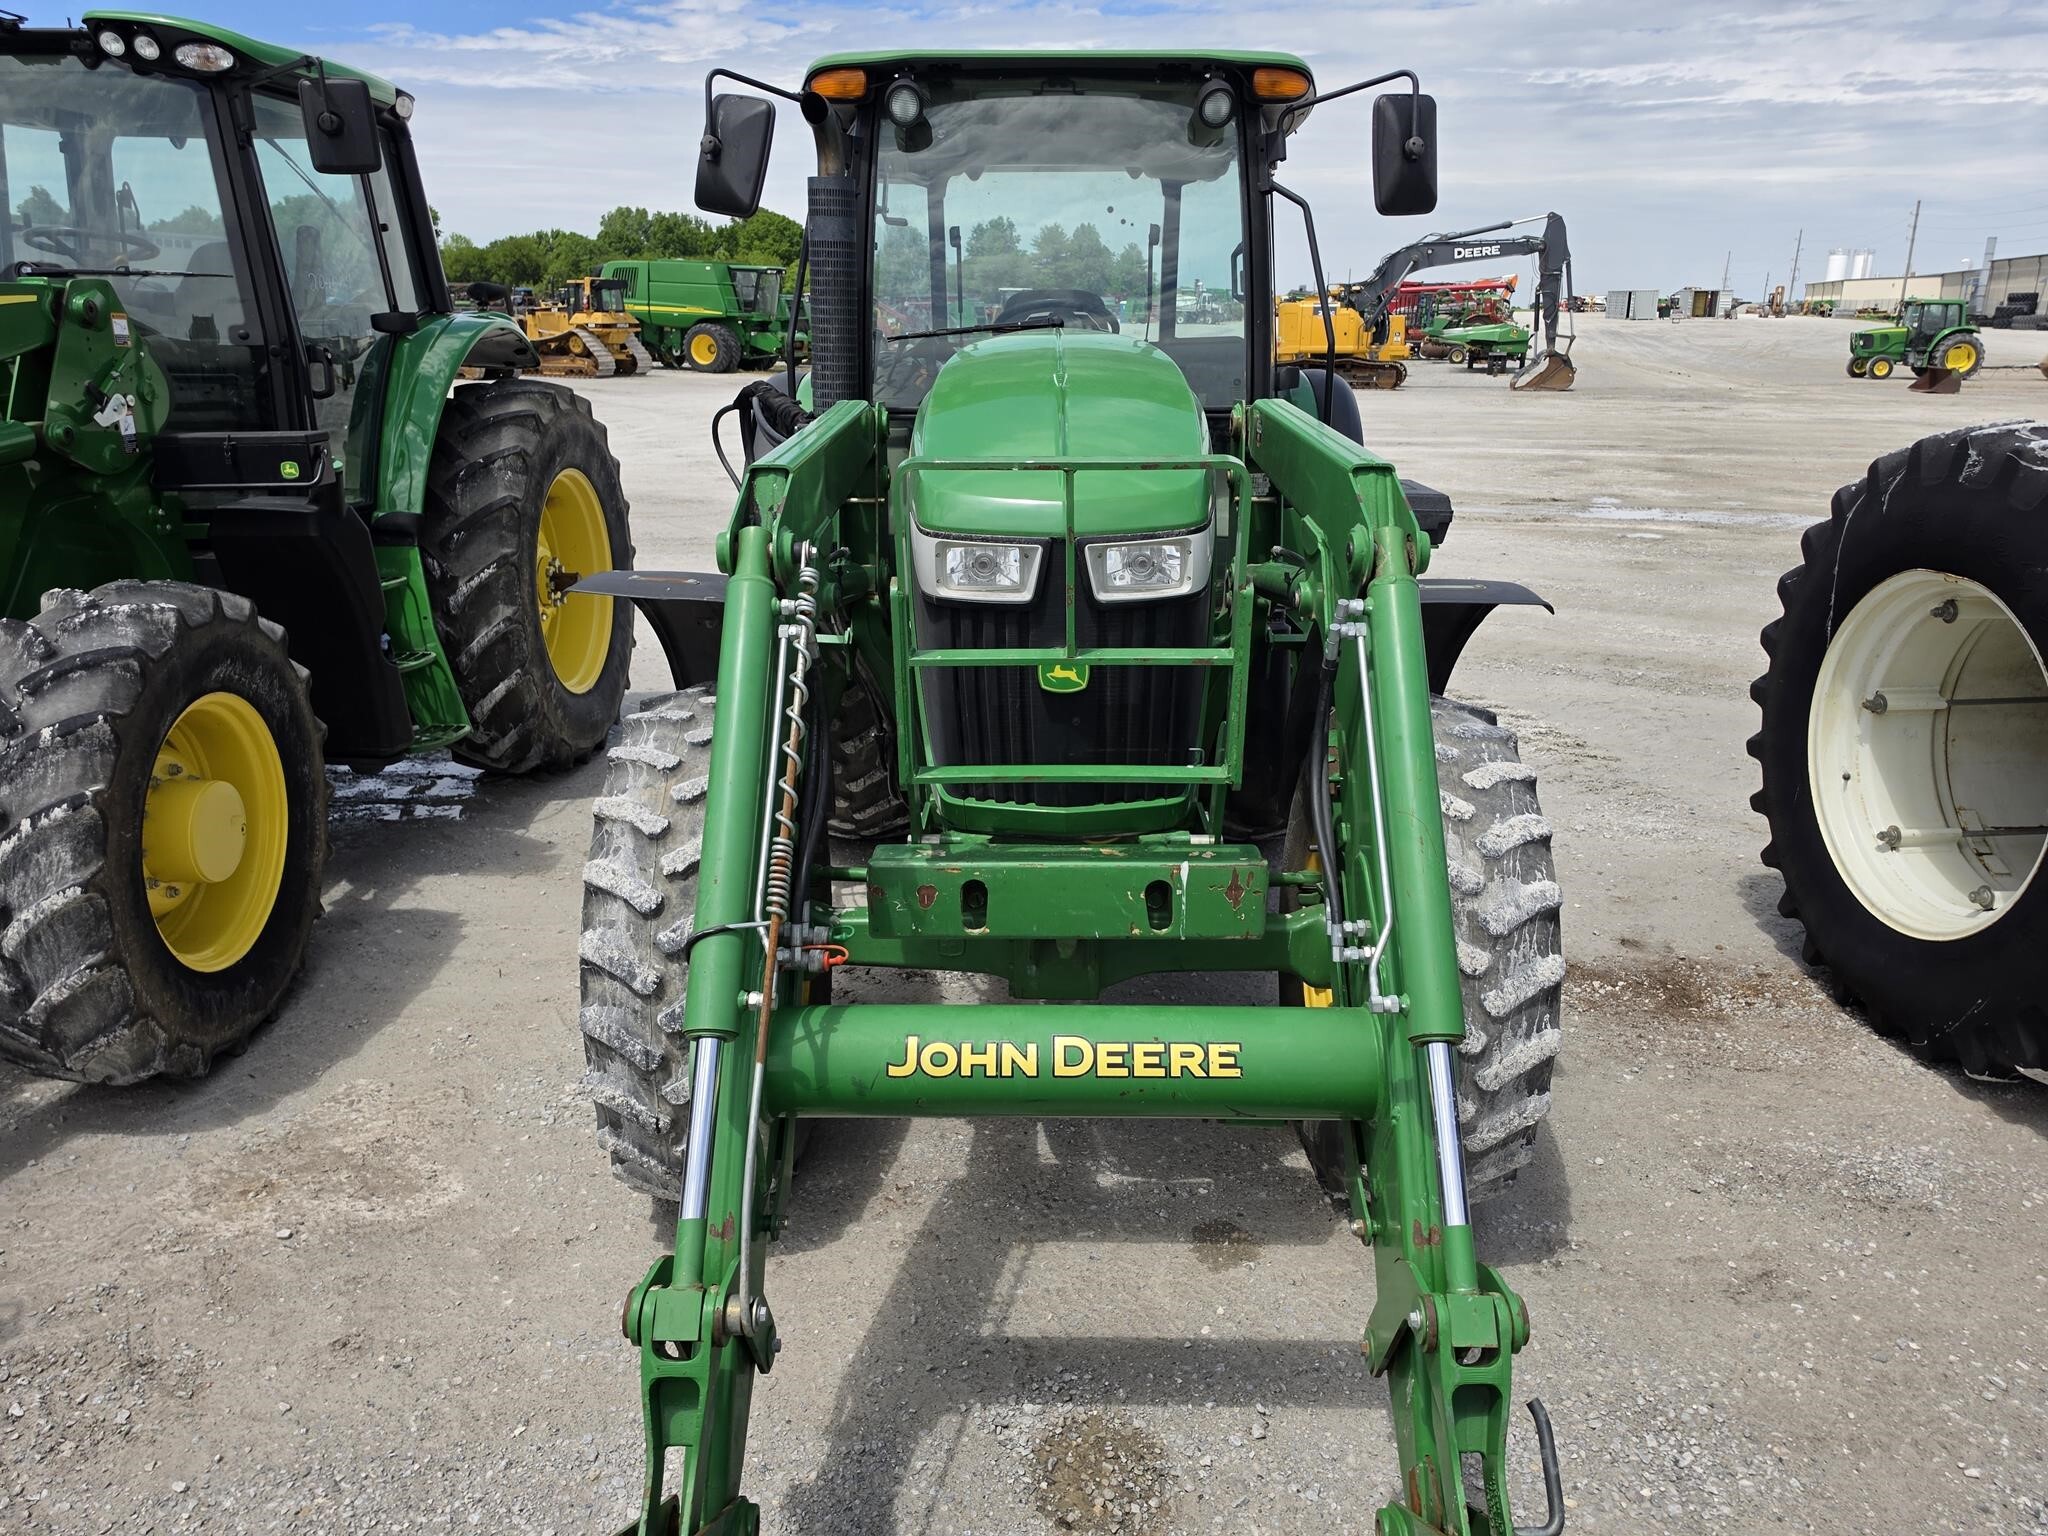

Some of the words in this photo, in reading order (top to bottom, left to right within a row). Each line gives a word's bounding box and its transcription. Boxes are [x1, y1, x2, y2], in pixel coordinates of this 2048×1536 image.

[1454, 245, 1501, 259] DEERE
[886, 1035, 1039, 1078] JOHN
[1052, 1035, 1242, 1079] DEERE
